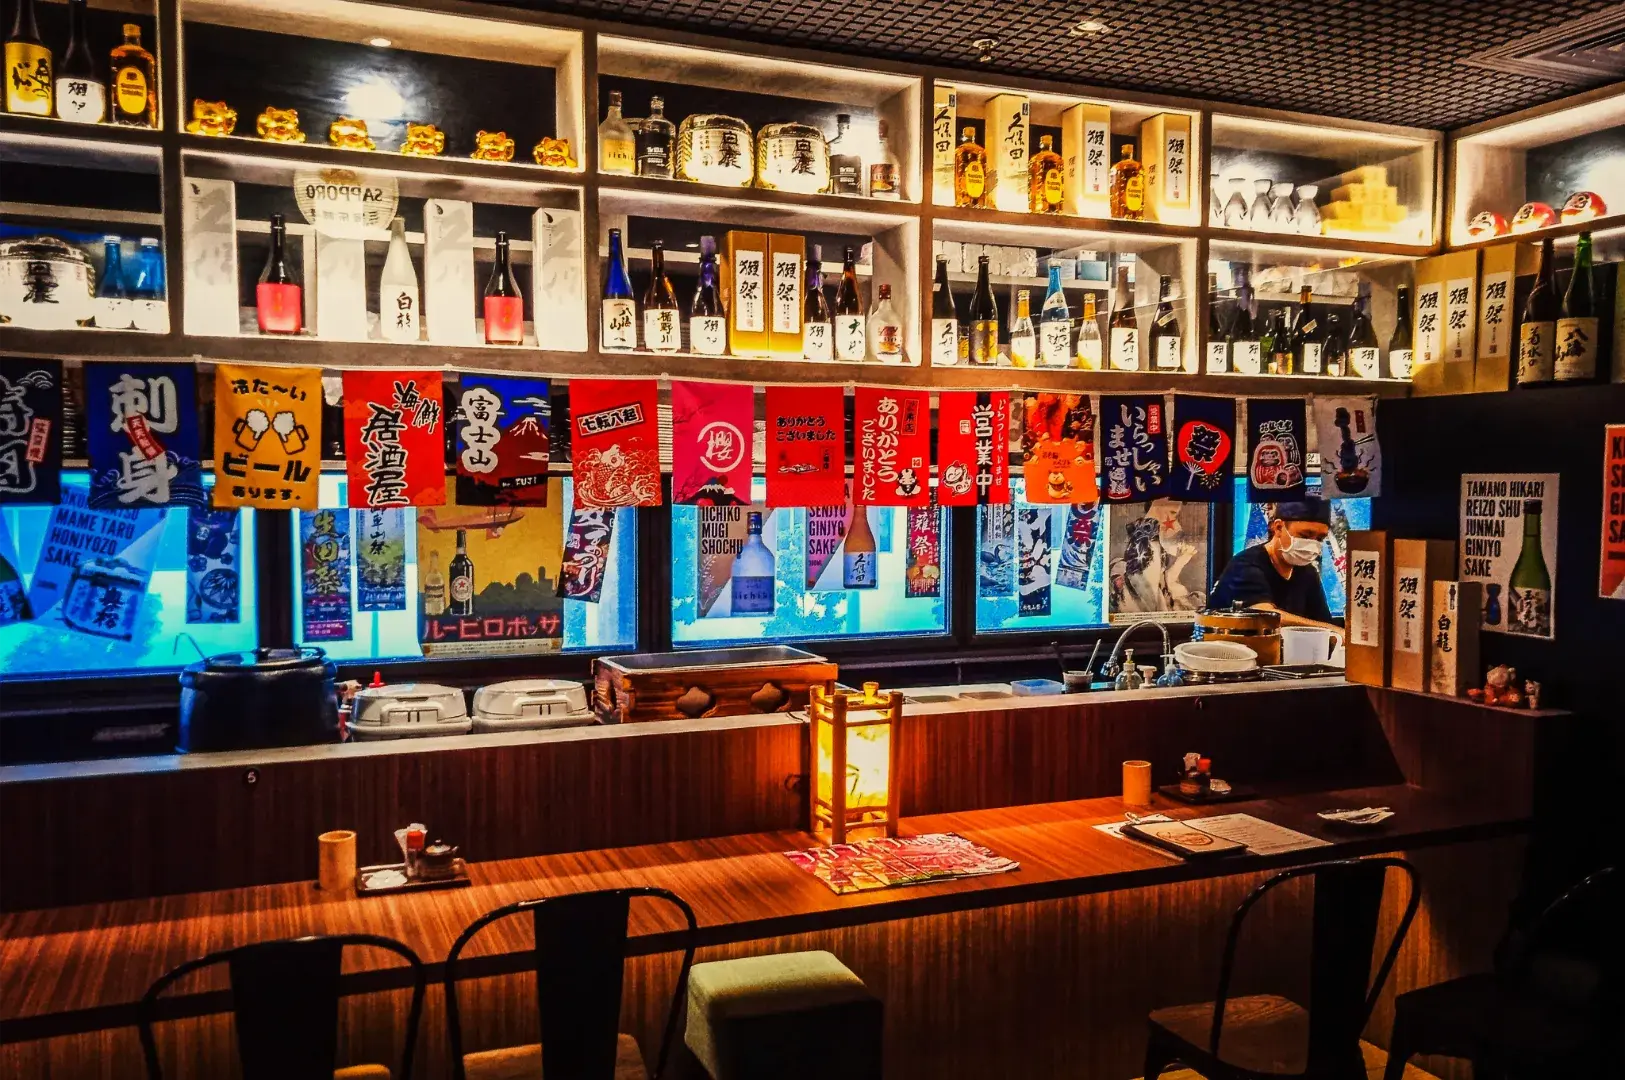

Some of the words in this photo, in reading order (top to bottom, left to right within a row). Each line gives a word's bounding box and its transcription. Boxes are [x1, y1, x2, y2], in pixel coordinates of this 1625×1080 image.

[394, 381, 440, 434] 海鮮
[582, 407, 638, 432] 七転八起
[776, 415, 826, 428] ありがとう
[108, 372, 179, 504] 刺身
[468, 395, 494, 467] 富士山
[776, 429, 837, 442] ございました
[877, 396, 899, 483] ありがとう
[361, 402, 410, 506] 居酒屋
[861, 417, 878, 501] ございました
[971, 403, 995, 497] 営業中
[222, 451, 312, 483] ビール
[515, 476, 538, 486] FUJI
[1466, 480, 1507, 498] TAMANO
[1509, 480, 1545, 498] HIKARI
[701, 506, 741, 522] IICHIKO
[808, 505, 847, 518] SENJYU
[1465, 499, 1496, 517] REIZO
[1498, 499, 1521, 518] SHU
[56, 507, 96, 531] MAME
[100, 516, 136, 540] TARU
[701, 522, 729, 539] MUGI
[809, 520, 844, 537] GINJYO
[1465, 518, 1505, 538] JUNMAI
[50, 526, 118, 556] HONJYOZO
[701, 538, 744, 555] SHOCHU
[808, 538, 836, 555] SAKE
[1465, 538, 1501, 558] GINJYO
[44, 546, 83, 569] SAKE
[1464, 558, 1492, 577] SAKE
[1435, 613, 1453, 653] 白龍
[247, 772, 256, 783] 5
